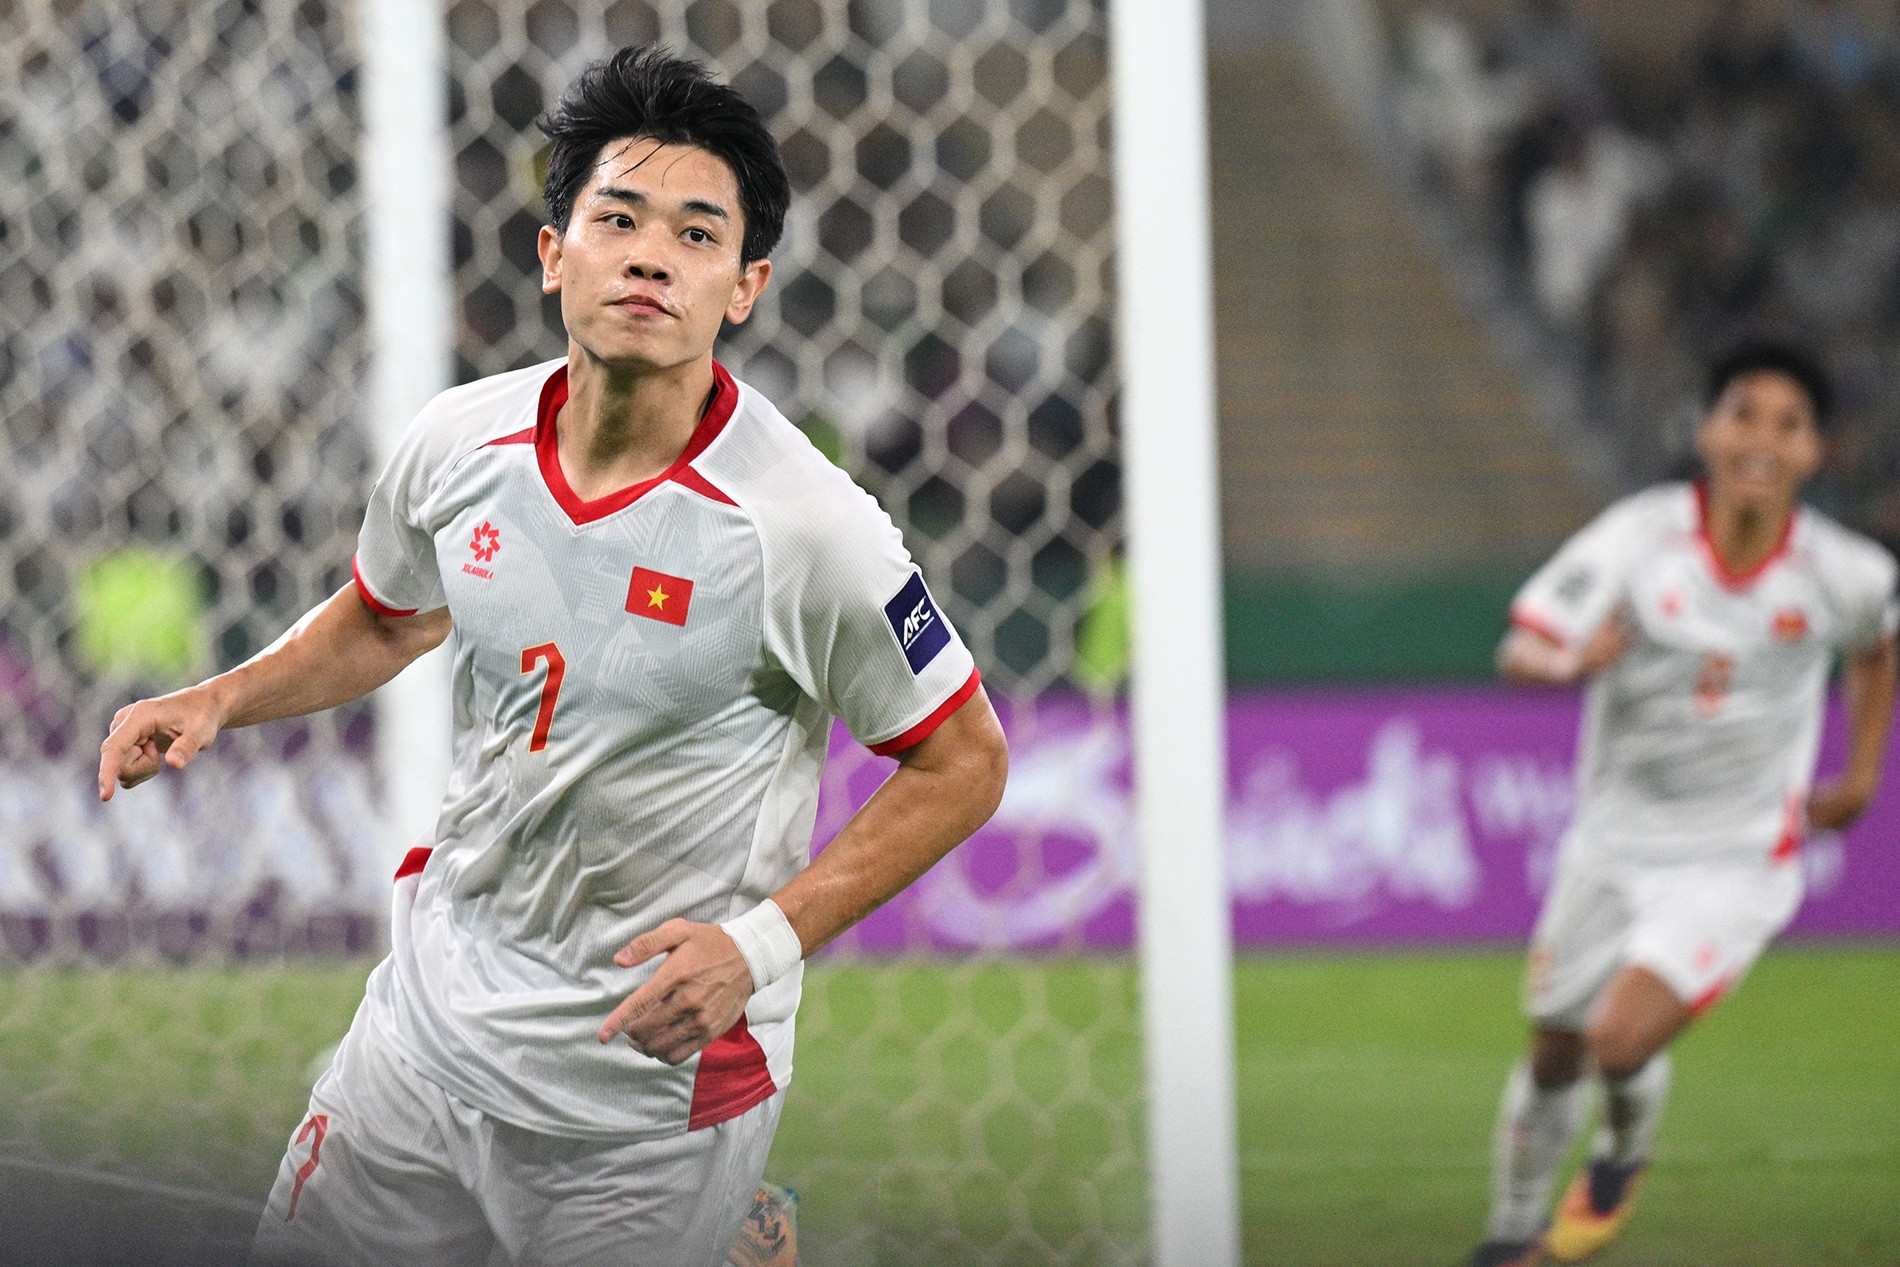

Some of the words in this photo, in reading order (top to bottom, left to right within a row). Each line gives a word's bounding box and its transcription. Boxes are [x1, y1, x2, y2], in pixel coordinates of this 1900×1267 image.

[904, 596, 931, 645] AFC
[520, 641, 567, 753] 7
[285, 1114, 328, 1222] 7
